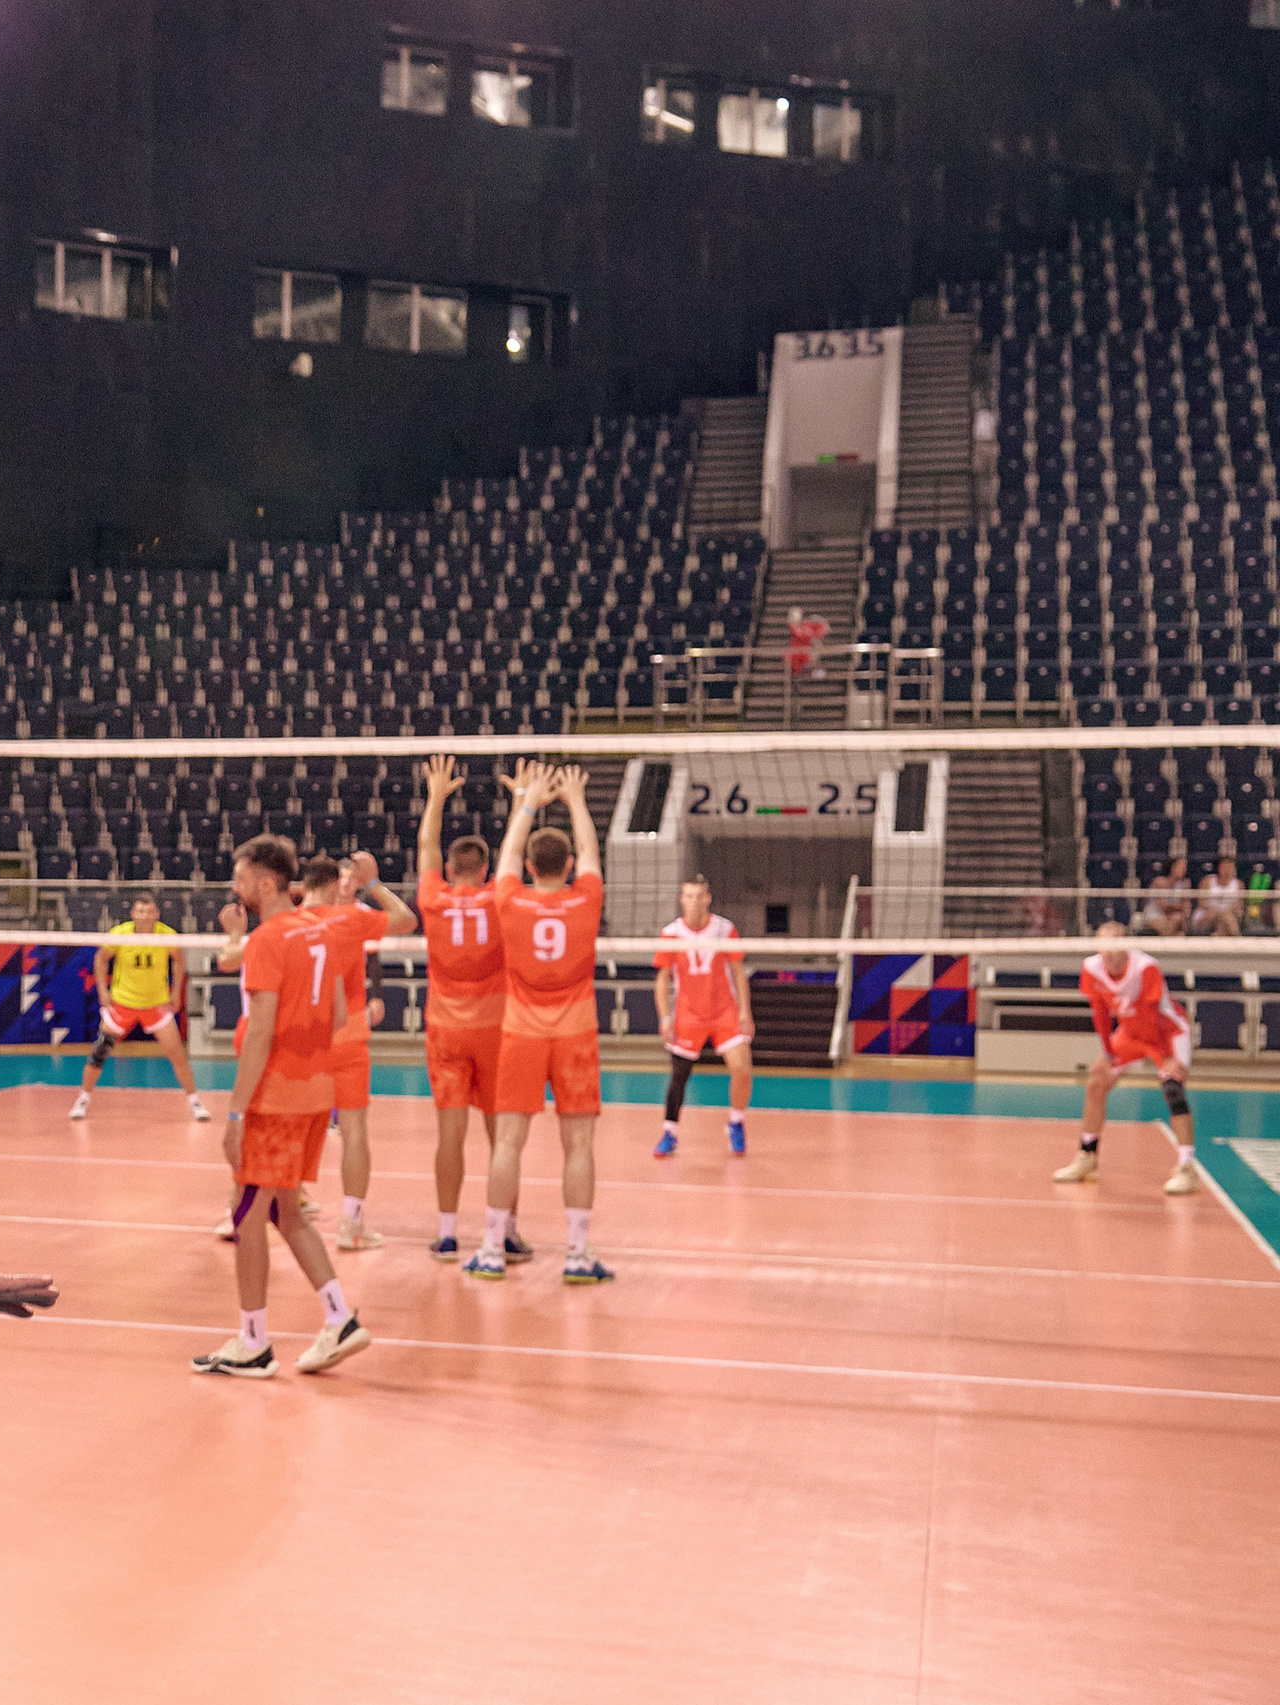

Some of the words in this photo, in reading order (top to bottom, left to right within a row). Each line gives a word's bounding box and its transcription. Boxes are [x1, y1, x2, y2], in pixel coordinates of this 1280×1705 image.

[688, 783, 749, 815] 2.6
[818, 783, 877, 815] 2.5
[442, 907, 489, 946] 11
[532, 917, 567, 962] 9
[134, 953, 153, 969] 11
